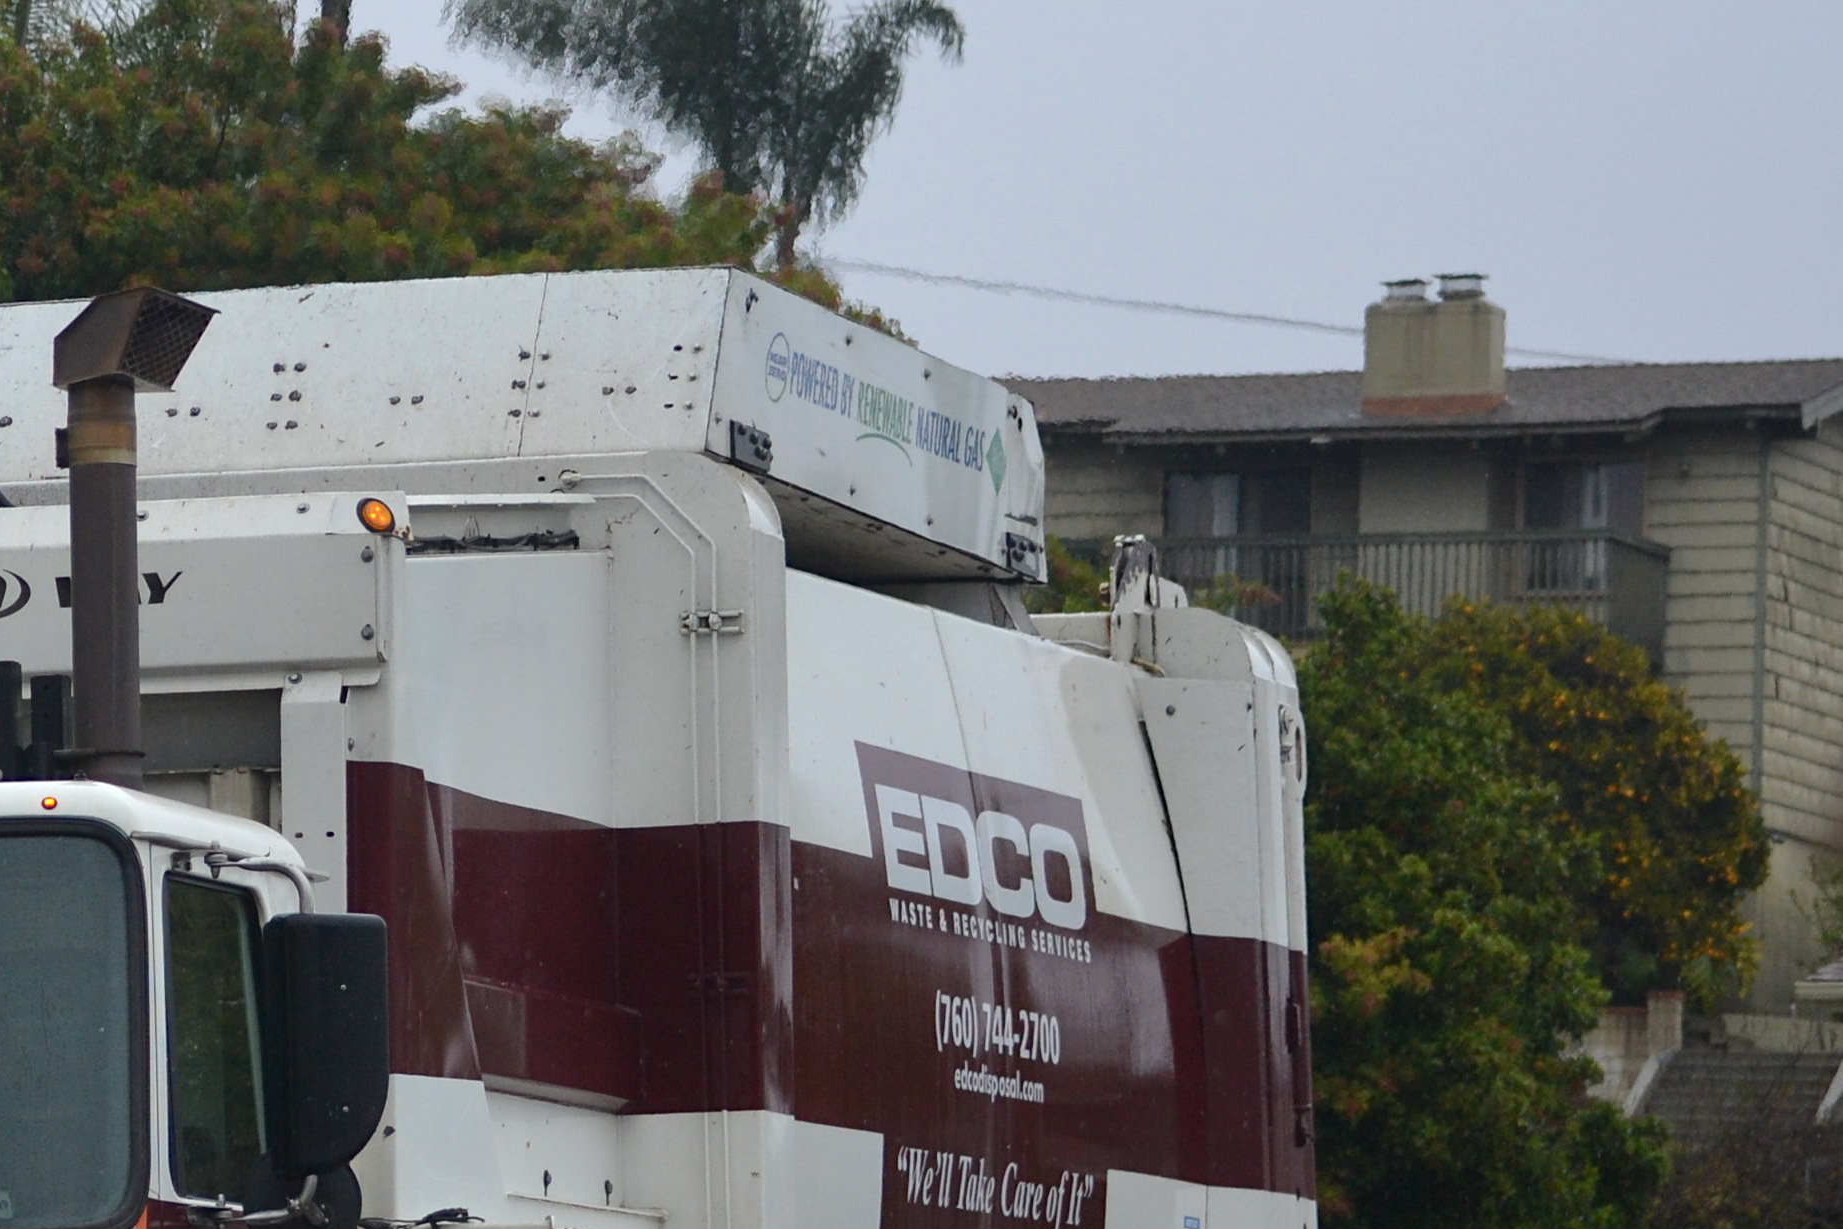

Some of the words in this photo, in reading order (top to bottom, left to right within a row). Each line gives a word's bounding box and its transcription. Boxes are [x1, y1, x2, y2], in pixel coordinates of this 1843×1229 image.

[789, 352, 838, 411] POWERED
[840, 374, 855, 418] BY
[856, 381, 915, 445] RENEWABLE
[916, 406, 961, 464] NATURAL
[964, 426, 985, 473] GAS
[875, 784, 1088, 931] EDCO
[889, 897, 934, 930] WASTE
[938, 910, 948, 931] &
[953, 911, 1027, 949] RECYCLING
[1031, 929, 1093, 964] SERVICES
[935, 989, 979, 1058] (760)
[982, 1004, 1061, 1066] 744-2700
[954, 1061, 1045, 1104] edcodisposal.com
[956, 1155, 995, 1215] Take
[1000, 1161, 1044, 1221] Care
